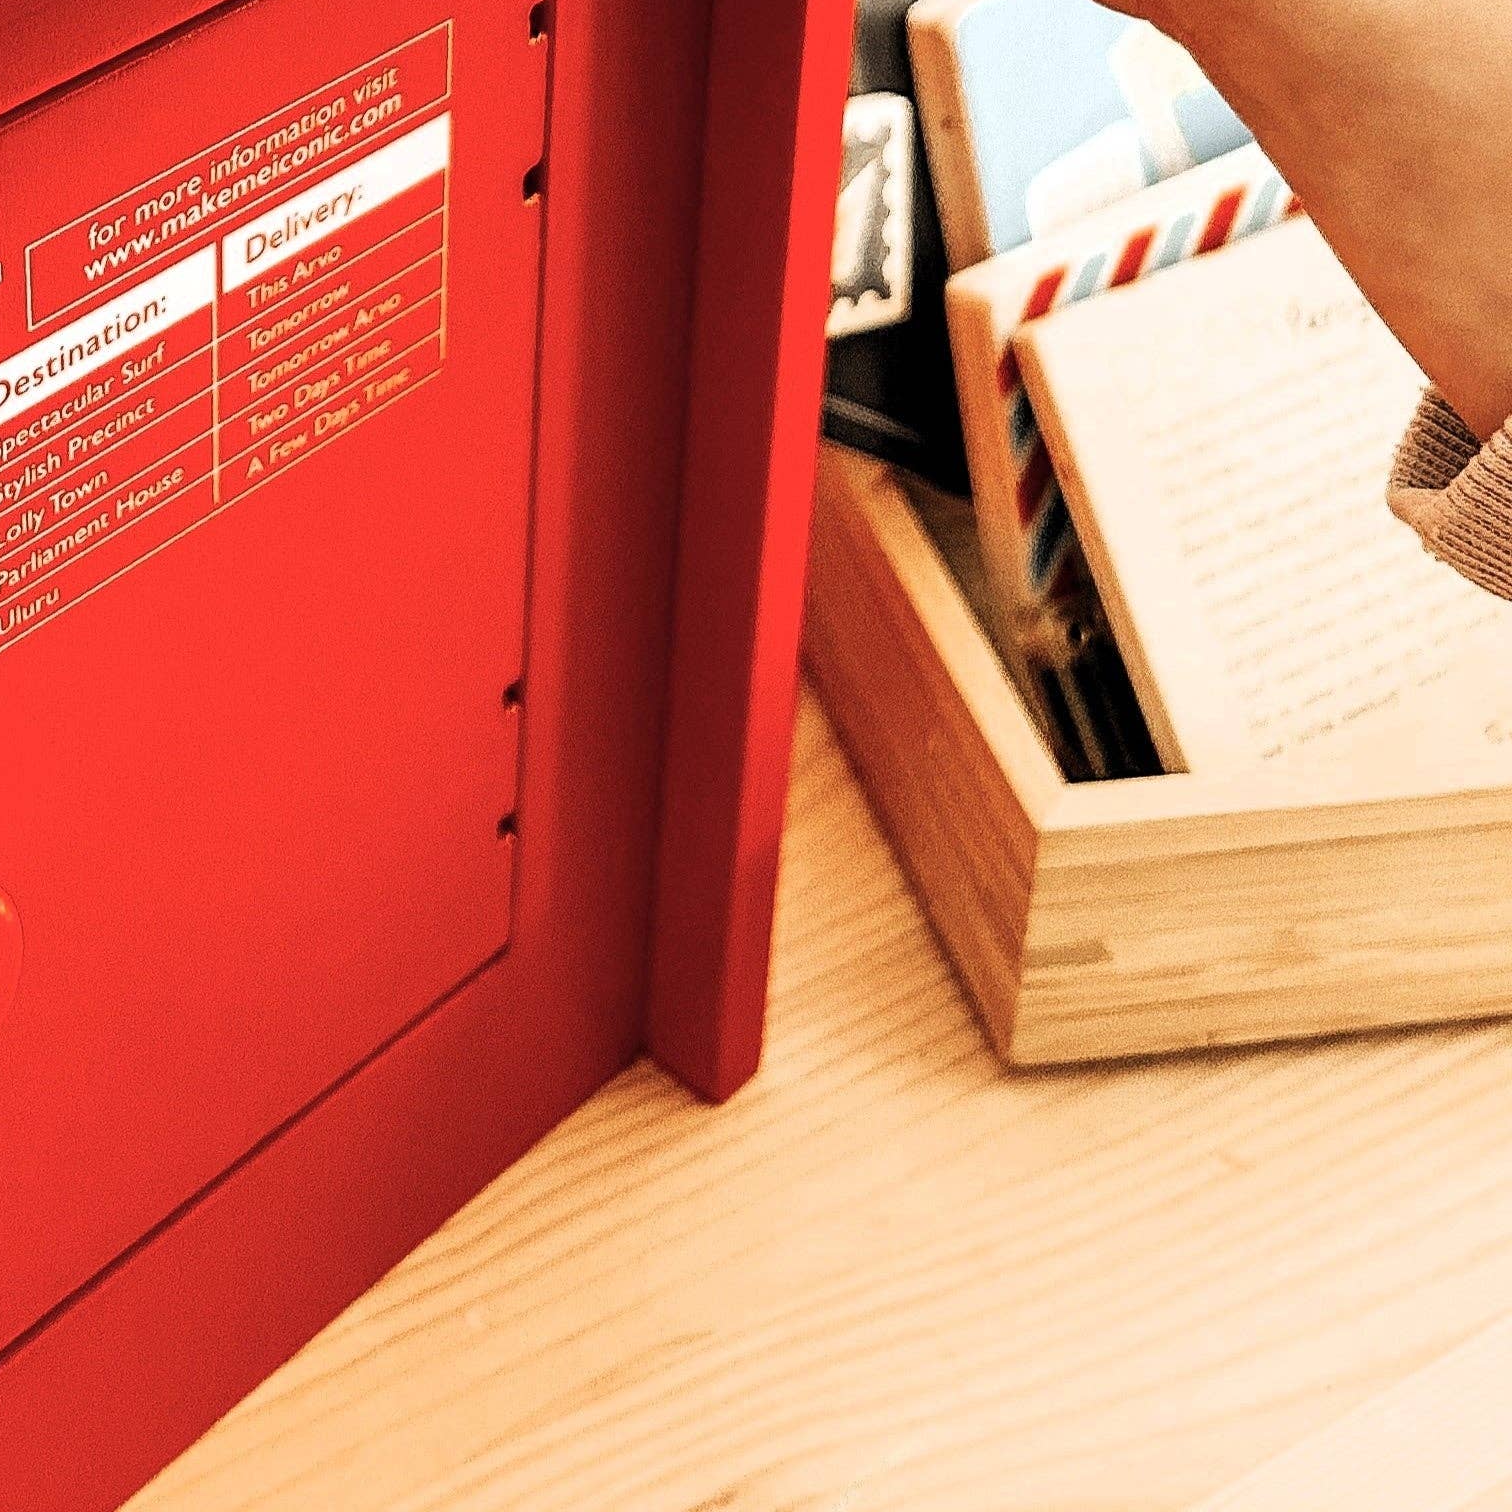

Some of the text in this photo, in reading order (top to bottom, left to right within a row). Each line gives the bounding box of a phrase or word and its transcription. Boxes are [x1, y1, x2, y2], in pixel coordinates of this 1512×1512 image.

[83, 93, 402, 281] www.makemeiconic.com
[88, 67, 399, 251] for more information visit
[245, 186, 363, 265] Delivery:
[245, 245, 343, 309] This Arvo
[245, 281, 351, 352] Tomorrow
[246, 293, 402, 394] Tomorrow Arvo
[120, 341, 166, 385] Surf
[68, 398, 155, 462] Precinct
[246, 403, 290, 436] Two
[293, 370, 341, 410] Days
[246, 456, 264, 479] A
[313, 398, 361, 437] Days
[48, 471, 108, 515] Town
[115, 467, 184, 520] House
